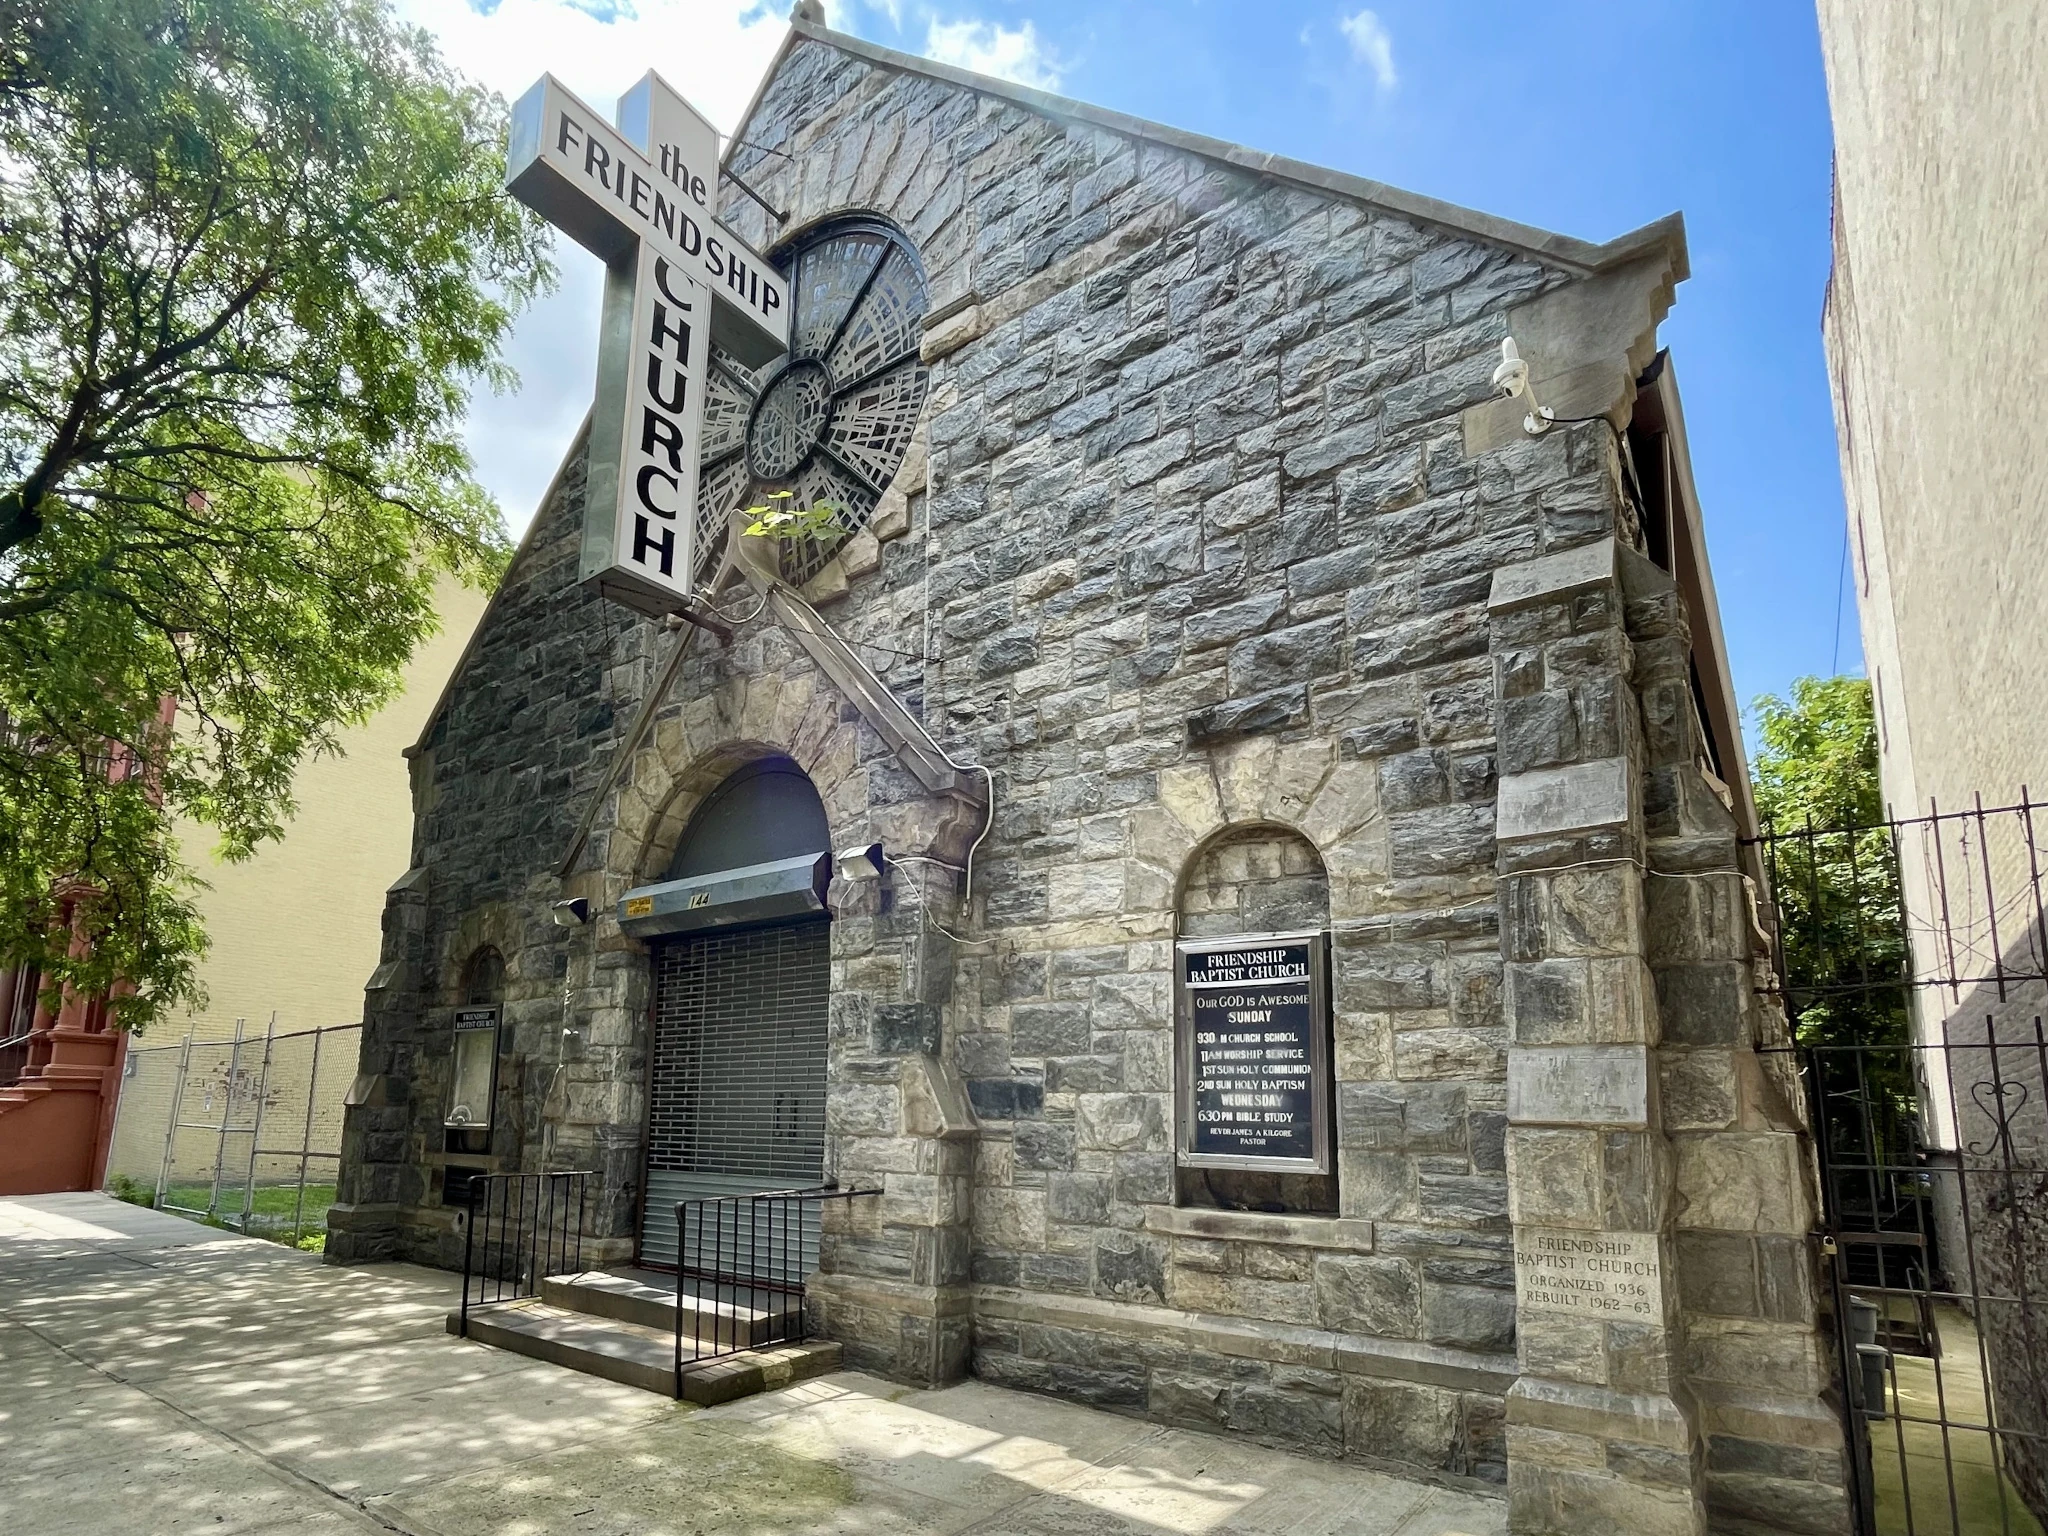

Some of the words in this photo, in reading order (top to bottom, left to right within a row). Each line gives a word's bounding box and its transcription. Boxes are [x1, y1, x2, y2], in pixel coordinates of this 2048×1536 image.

[658, 142, 706, 207] the
[557, 110, 780, 317] FRIENDSHIP
[631, 255, 693, 578] CHURCH
[690, 892, 710, 909] 144
[1207, 949, 1287, 968] FRIENDSHIP
[1190, 967, 1245, 983] BAPTIST
[1248, 963, 1306, 979] CHURCH
[1219, 995, 1245, 1008] GOD
[1227, 1010, 1272, 1023] SUNDAY
[1196, 1032, 1216, 1044] 930
[1228, 1033, 1261, 1043] CHURCH
[1264, 1032, 1299, 1043] SCHOOL
[1223, 1049, 1264, 1060] WORSHIP
[1265, 1048, 1305, 1060] SERVICE
[1202, 1065, 1217, 1077] 1ST
[1217, 1065, 1235, 1075] SUN
[1236, 1065, 1260, 1075] HOLY
[1196, 1080, 1215, 1092] 2ND
[1216, 1080, 1232, 1090] SUN
[1234, 1080, 1260, 1090] HOLY
[1261, 1080, 1306, 1090] BAPTISM
[1220, 1093, 1284, 1107] WEDNESDAY
[1236, 1111, 1262, 1122] BIBLE
[1264, 1112, 1294, 1123] STUDY
[1263, 1129, 1293, 1138] KILGORE
[1239, 1137, 1267, 1146] PASTOR
[1538, 1236, 1632, 1256] FRIENDSHIP
[1516, 1251, 1577, 1269] BAPTIST
[1587, 1258, 1658, 1277] CHURCH
[1530, 1274, 1605, 1292] ORGANIZED
[1614, 1282, 1646, 1297] 1936
[1526, 1289, 1581, 1306] REBUILT
